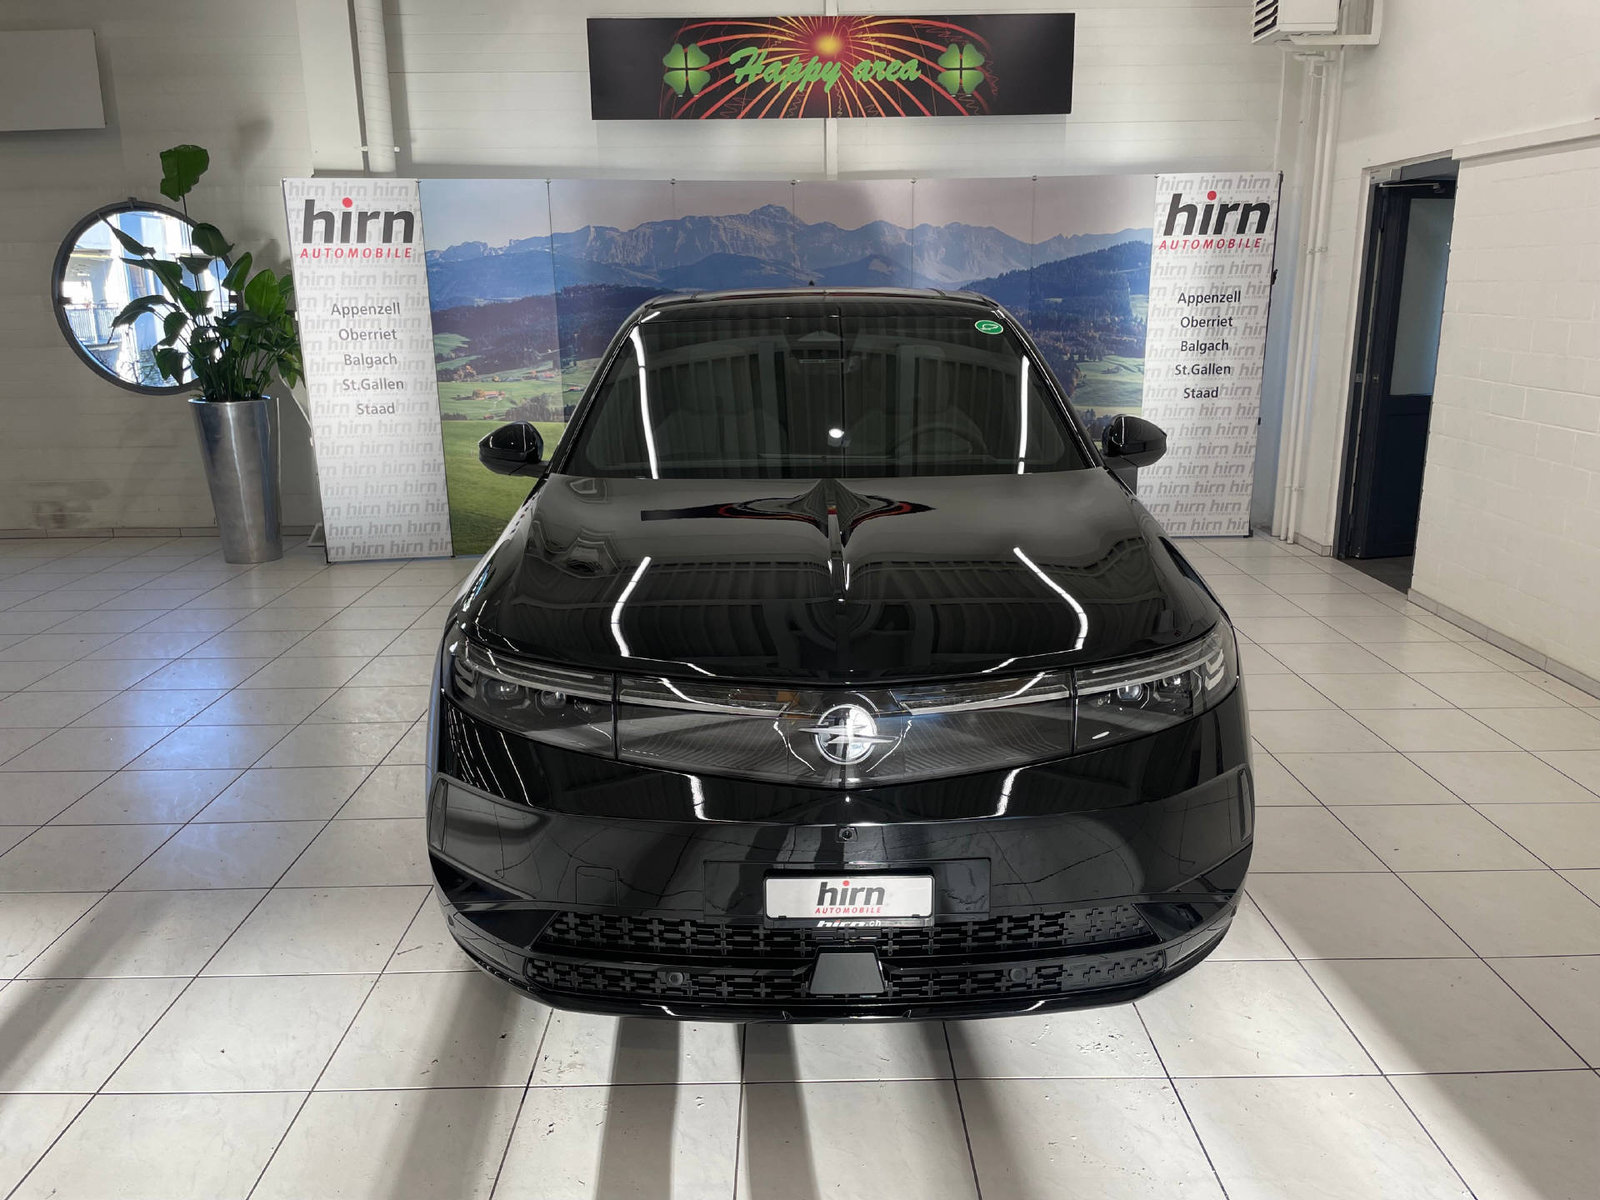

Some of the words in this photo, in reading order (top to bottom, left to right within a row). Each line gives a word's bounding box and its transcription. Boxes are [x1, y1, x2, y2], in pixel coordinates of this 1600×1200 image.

[729, 46, 841, 93] Happy
[852, 58, 921, 81] area
[1163, 190, 1271, 236] hirn
[302, 197, 415, 244] hirn
[1159, 238, 1262, 250] AUTOMOBILE
[300, 247, 412, 259] AUTOMOBILE
[1177, 290, 1241, 306] Appenzell
[331, 302, 400, 318] Appenzell
[1180, 316, 1233, 328] Oberriet
[338, 328, 397, 341] Oberriet
[1180, 339, 1229, 354] Balgach
[344, 353, 397, 368] Balgach
[1174, 363, 1231, 376] St.Gallen
[342, 378, 404, 391] St.Gallen
[1183, 386, 1219, 399] Staad
[357, 402, 395, 415] Staad
[817, 880, 885, 906] hirn
[814, 906, 882, 915] AUTOMOBILE
[816, 919, 882, 928] hirn.ch
